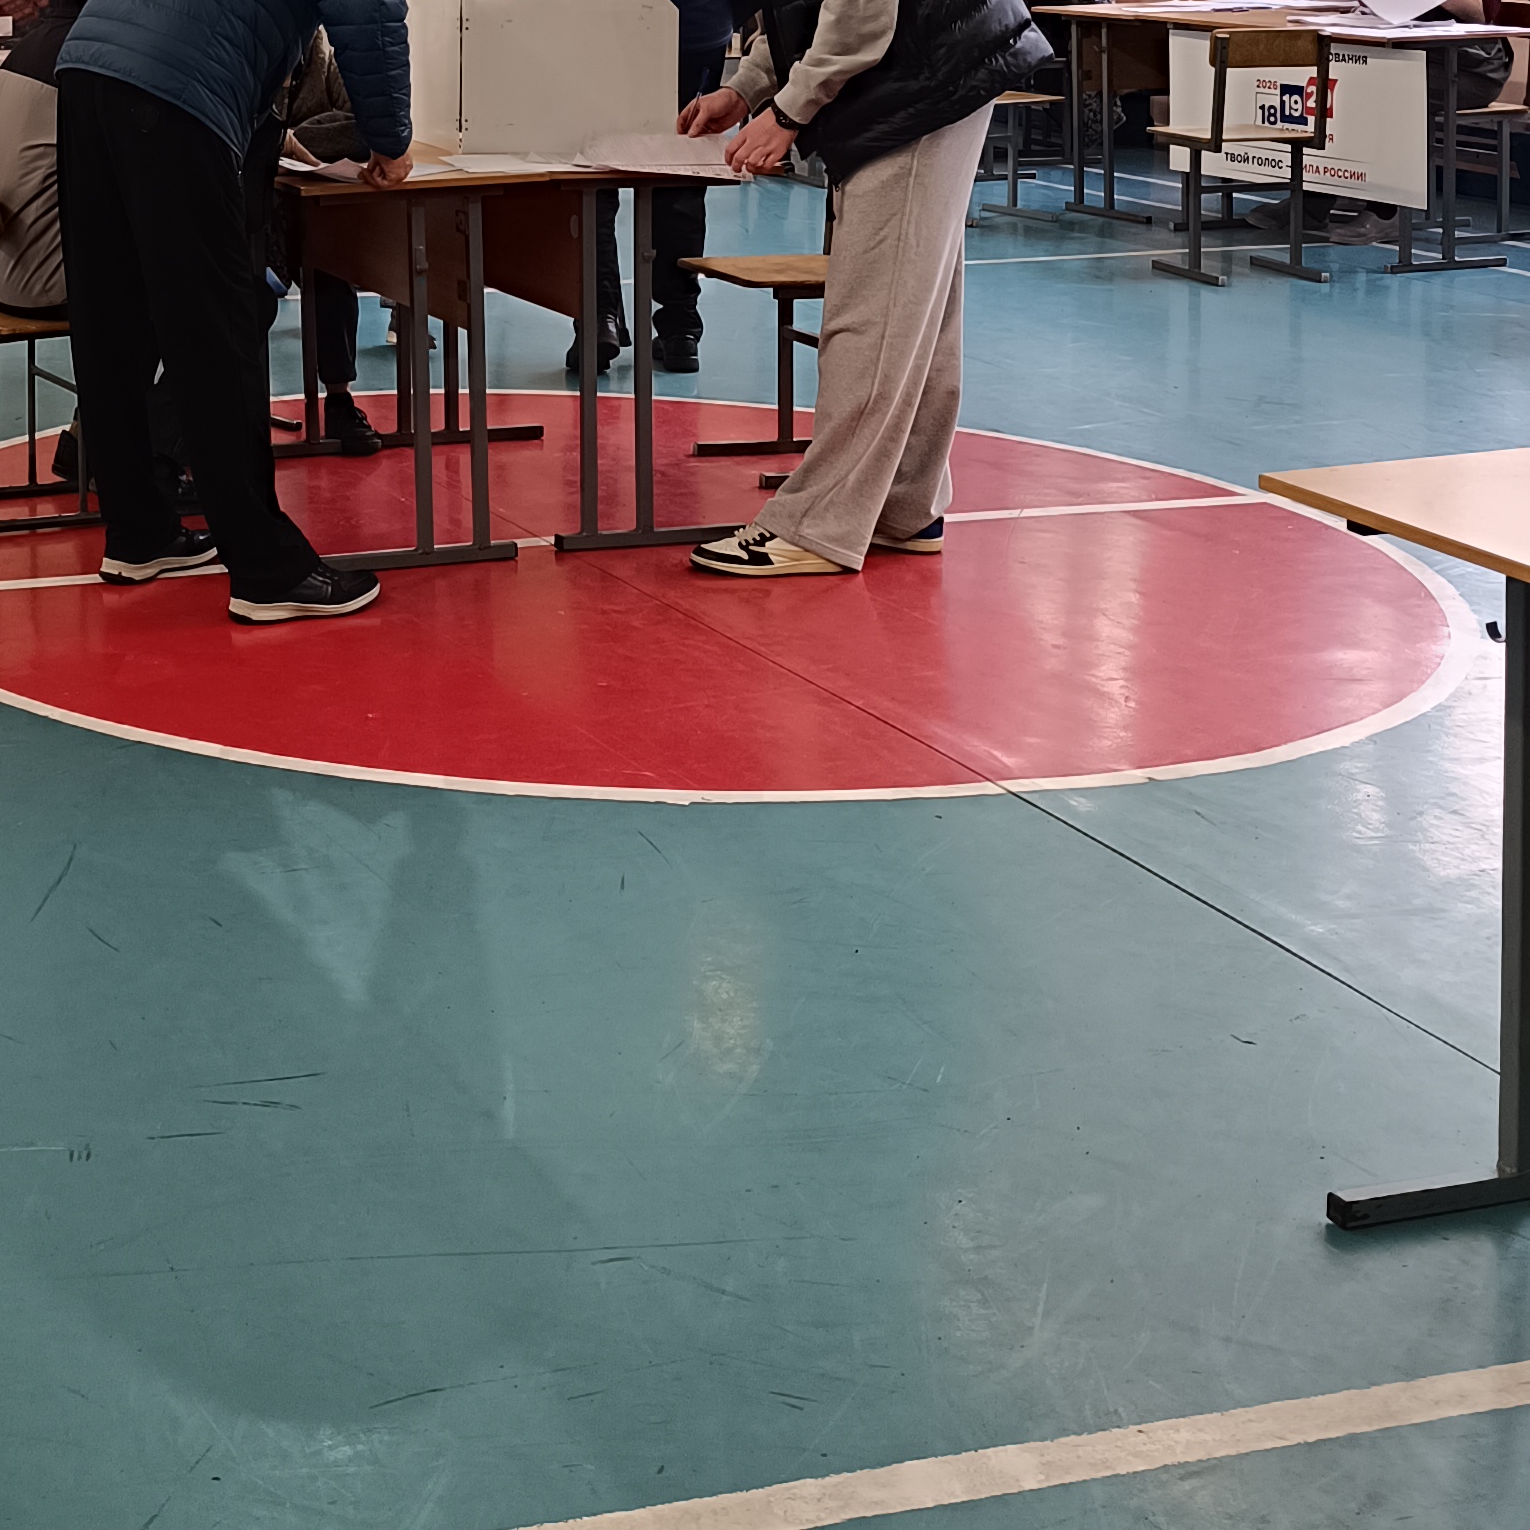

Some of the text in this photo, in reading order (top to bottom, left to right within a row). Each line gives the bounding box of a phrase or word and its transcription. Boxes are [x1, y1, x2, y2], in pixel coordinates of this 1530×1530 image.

[1328, 52, 1368, 66] ОВАНИЯ
[1256, 78, 1278, 90] 2026
[1258, 103, 1278, 126] 18
[1282, 93, 1303, 117] 19
[1224, 151, 1367, 183] ТВОЙ ГОЛОС ИЛА РОССИИ!
